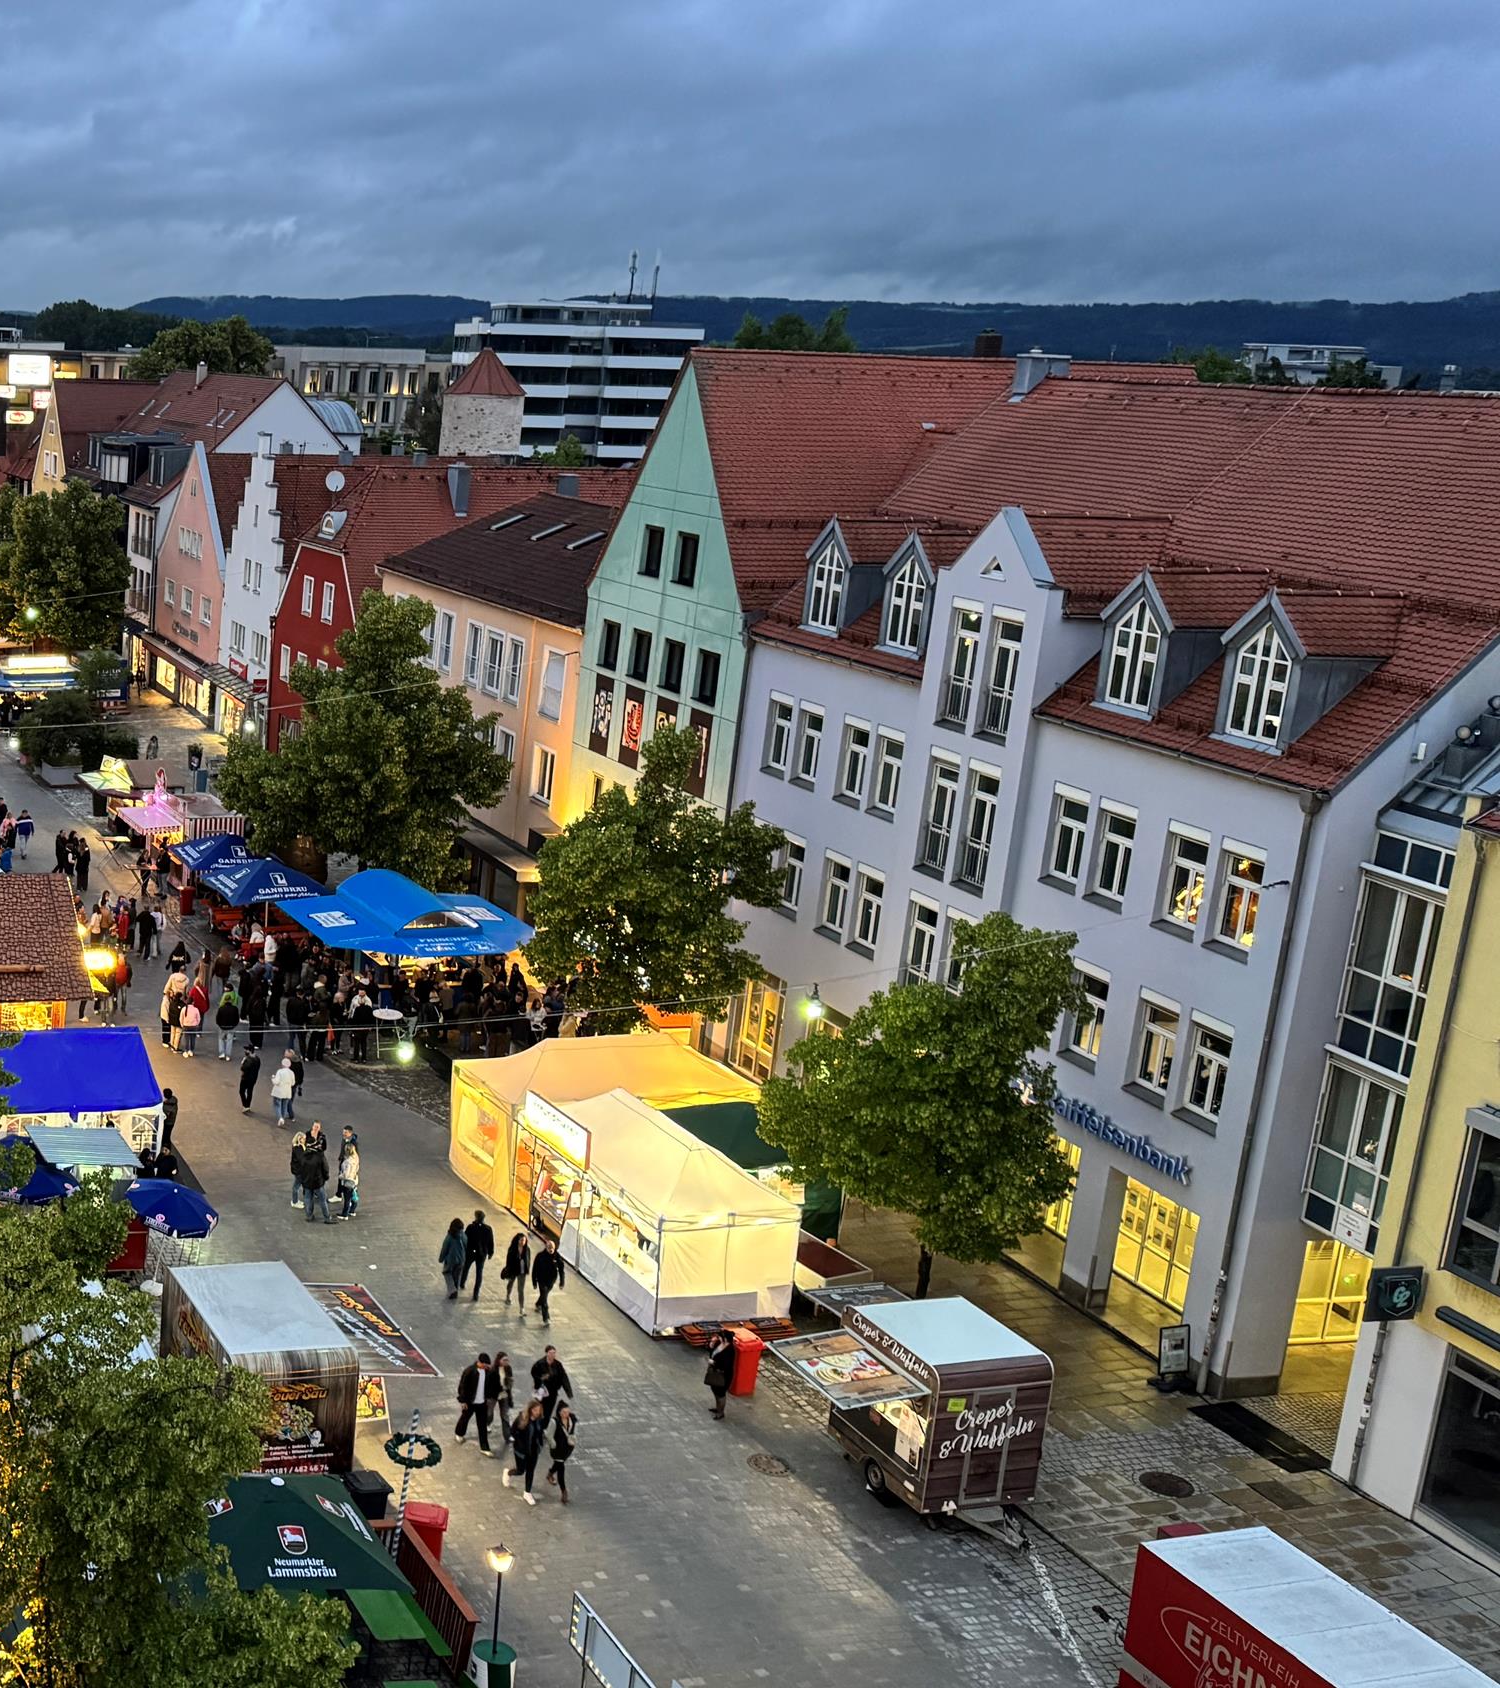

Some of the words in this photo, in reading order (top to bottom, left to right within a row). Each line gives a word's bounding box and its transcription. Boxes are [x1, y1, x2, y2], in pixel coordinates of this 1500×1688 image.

[1050, 1090, 1192, 1186] aiffeisenbank
[955, 1398, 1016, 1431] Crepes
[950, 1416, 1037, 1454] Waffeln
[267, 1566, 337, 1578] Lammsbräu
[274, 1557, 325, 1566] Neumarkter
[1210, 1616, 1300, 1688] ZELTVERLEIH
